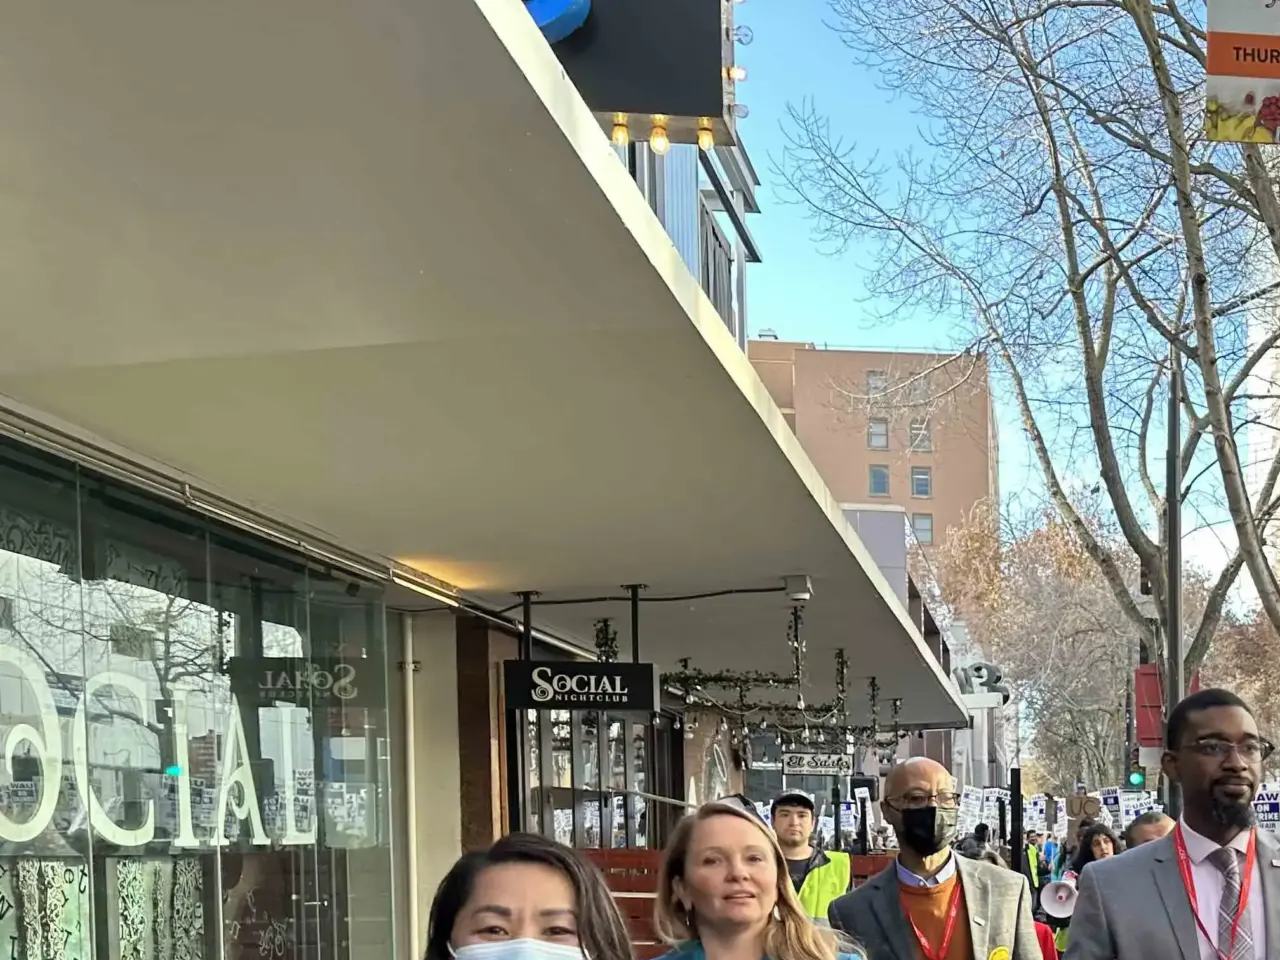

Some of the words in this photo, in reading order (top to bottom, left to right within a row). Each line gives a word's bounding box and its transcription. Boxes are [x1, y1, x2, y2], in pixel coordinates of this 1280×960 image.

[556, 694, 628, 702] NIGHTCLUB
[0, 640, 316, 846] OCIAL
[788, 756, 806, 768] El
[1257, 793, 1279, 801] AW
[1257, 804, 1269, 812] ON
